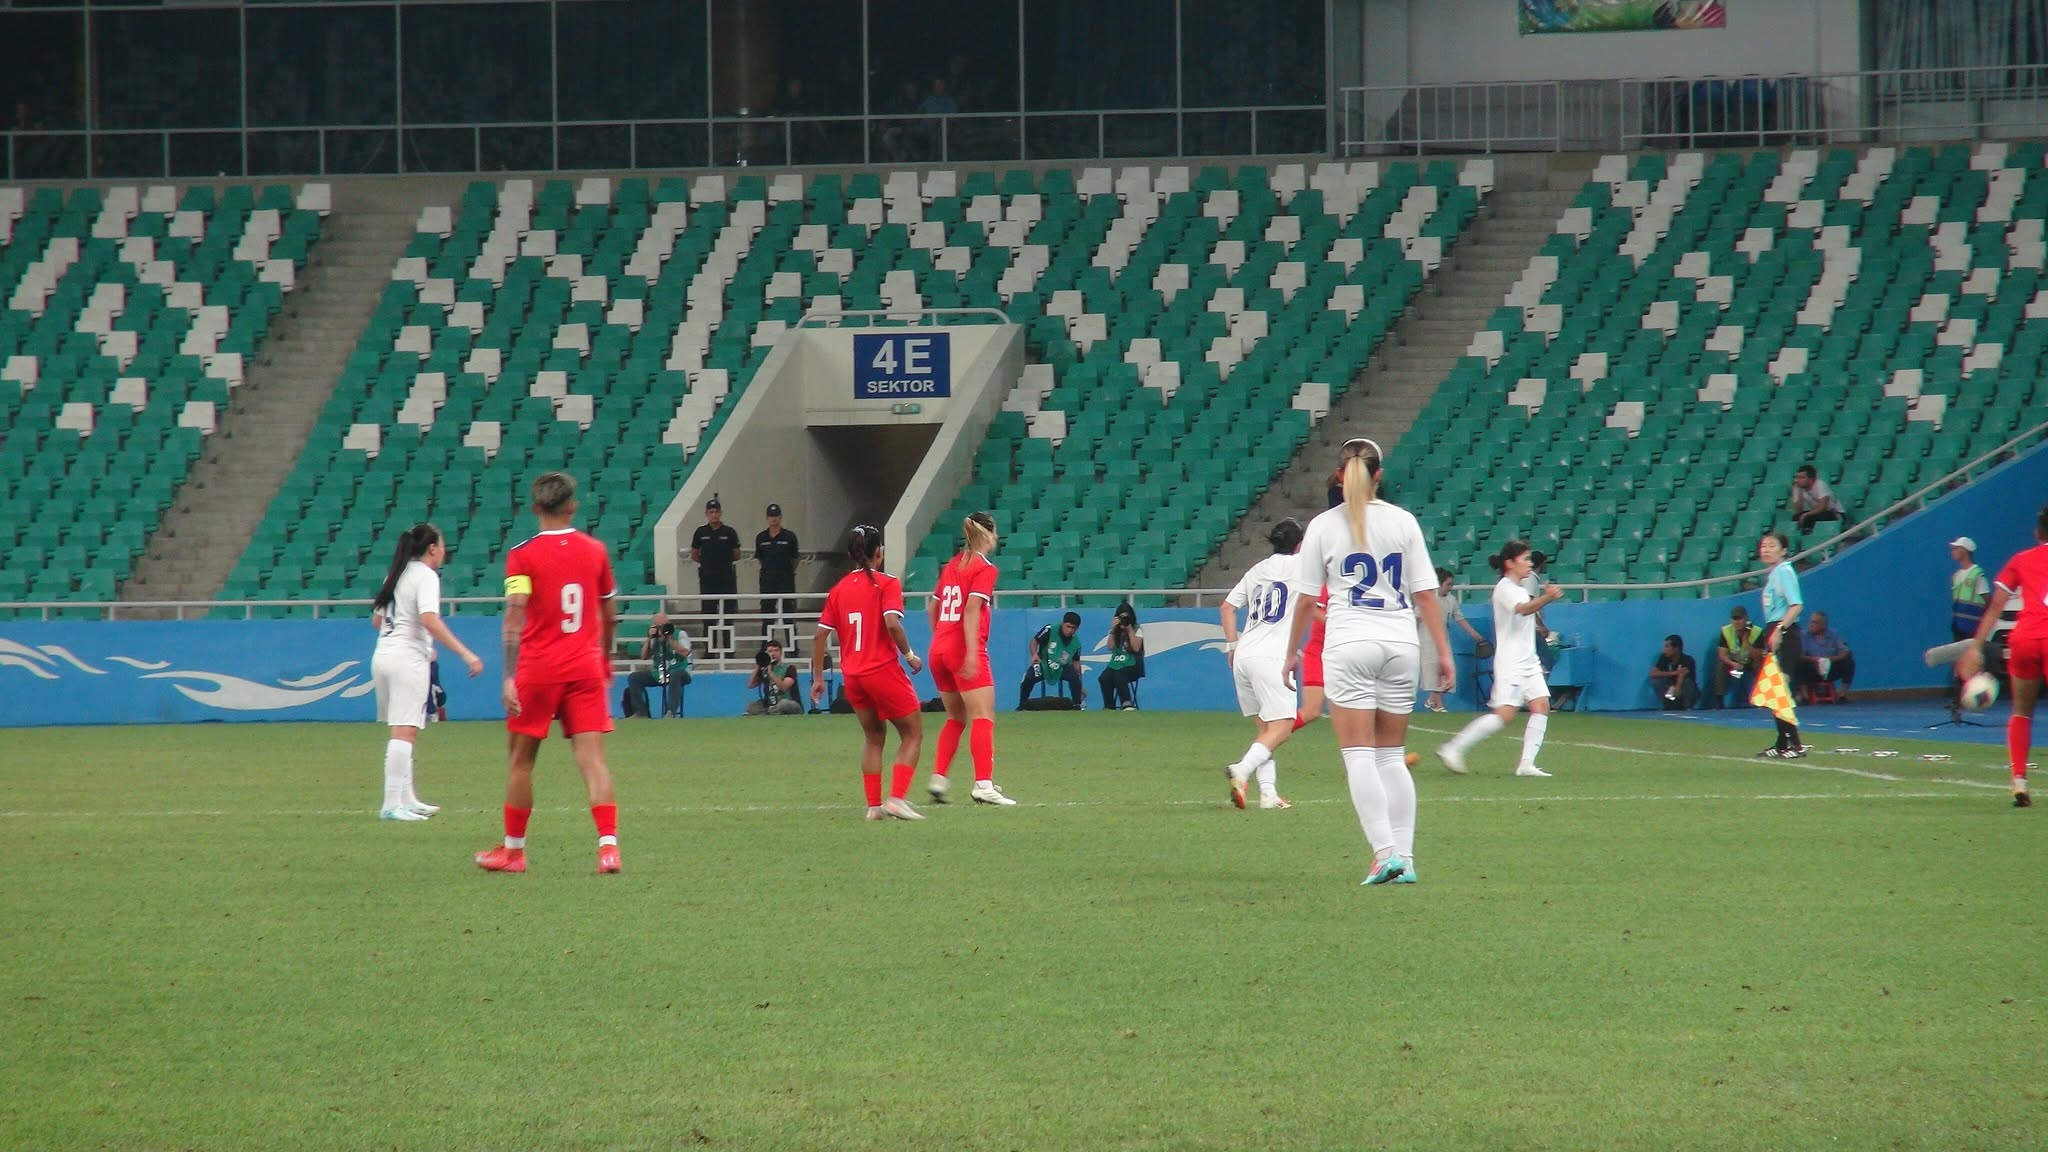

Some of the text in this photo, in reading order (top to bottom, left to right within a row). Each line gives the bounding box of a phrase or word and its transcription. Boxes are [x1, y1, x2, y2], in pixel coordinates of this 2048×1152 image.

[872, 338, 932, 375] 4E
[867, 379, 935, 393] SEKTOR
[1340, 552, 1408, 610] 21
[560, 583, 583, 633] 9
[939, 585, 962, 622] 22
[848, 612, 862, 651] 7
